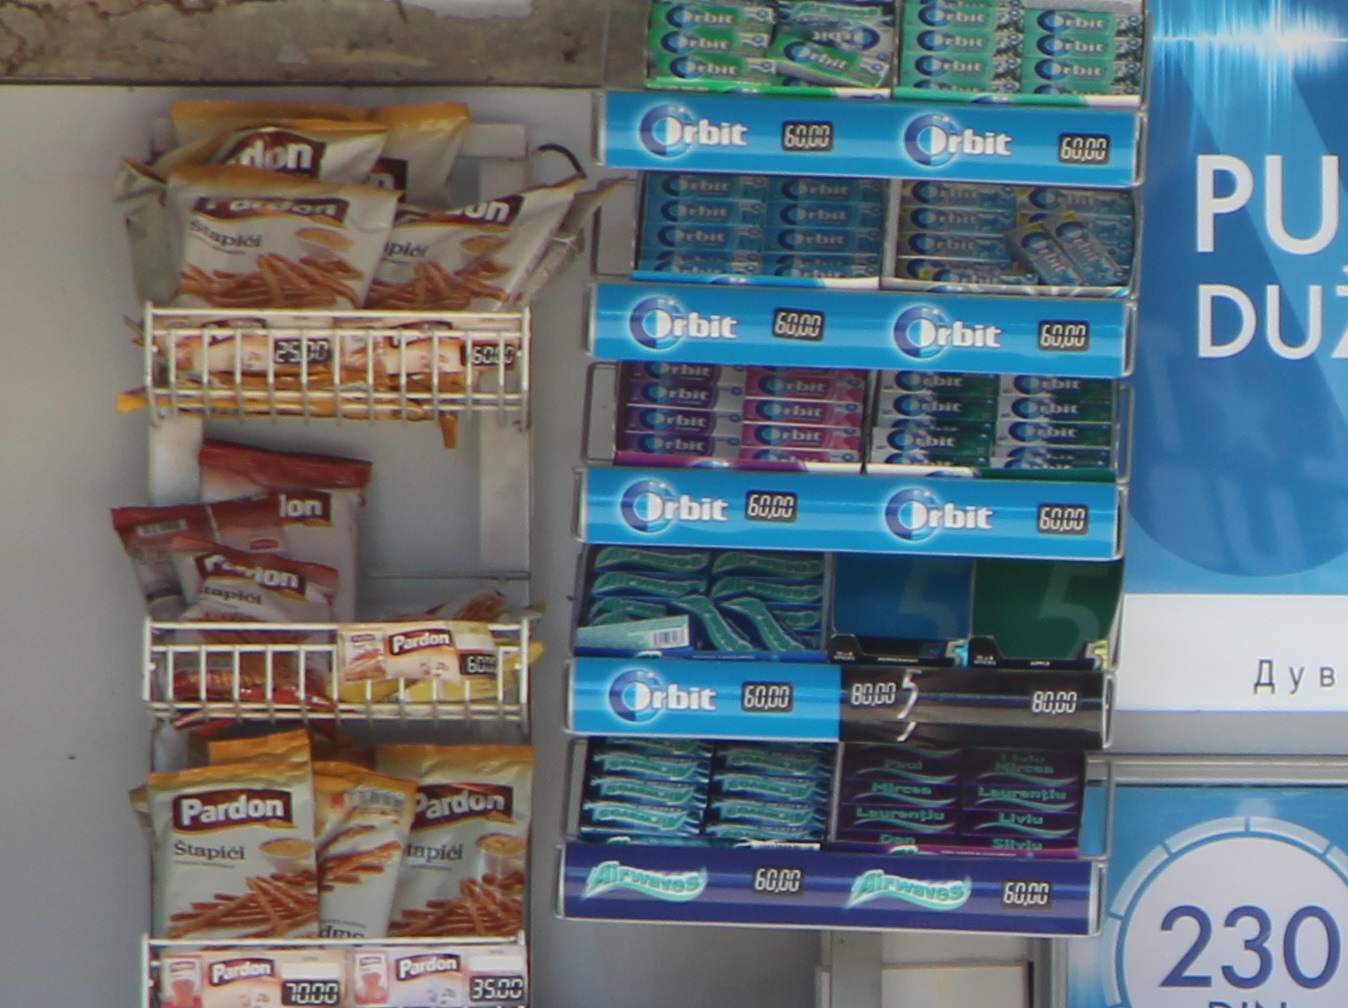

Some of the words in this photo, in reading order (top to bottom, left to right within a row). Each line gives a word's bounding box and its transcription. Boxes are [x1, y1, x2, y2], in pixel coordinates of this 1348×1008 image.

[640, 104, 748, 157] Orbit
[784, 124, 832, 148] 60,00
[904, 113, 1011, 166] Orbit
[1060, 137, 1108, 162] 60,00
[621, 480, 728, 534] Orbit
[747, 494, 796, 519] 60,00
[390, 631, 451, 656] Pardon
[609, 669, 716, 723] Orbit
[743, 685, 791, 710] 60,00
[851, 682, 896, 706] 80,00
[180, 794, 285, 825] Pardon
[173, 839, 246, 863] Štapići
[582, 862, 707, 902] Airwaves
[754, 869, 801, 893] 60,00
[1158, 904, 1342, 990] 230
[211, 959, 272, 985] Pardon
